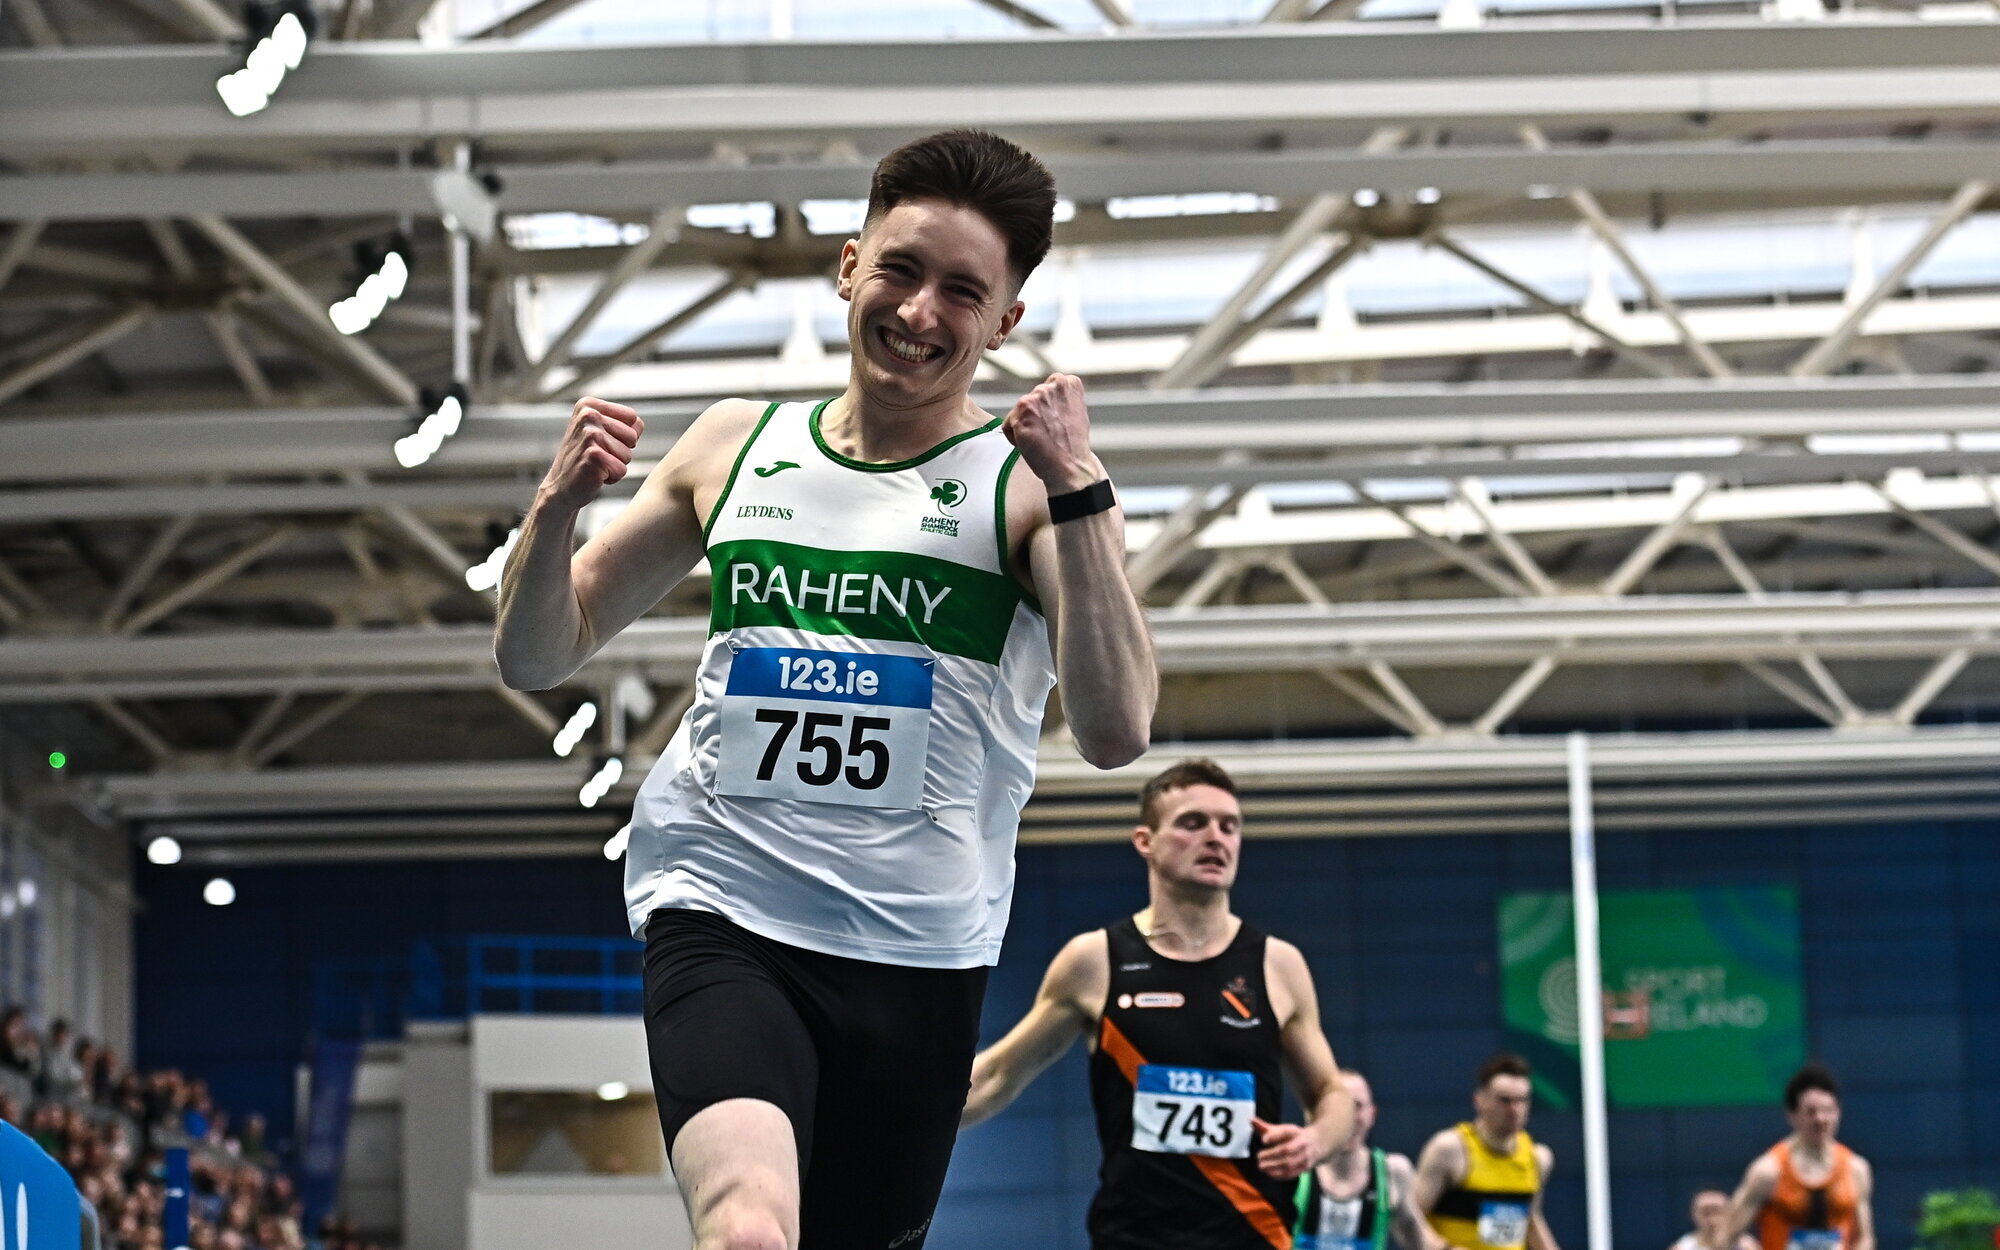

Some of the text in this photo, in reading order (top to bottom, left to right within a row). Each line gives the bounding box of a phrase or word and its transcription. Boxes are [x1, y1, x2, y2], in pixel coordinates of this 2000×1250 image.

[737, 505, 794, 521] LEYDENS
[921, 522, 959, 533] SHAMROCK
[922, 516, 960, 527] RAHENY
[731, 562, 952, 625] RAHENY
[778, 656, 879, 696] 123.ie
[754, 708, 891, 790] 755
[1167, 1070, 1227, 1096] 123.ie
[1156, 1102, 1233, 1147] 743
